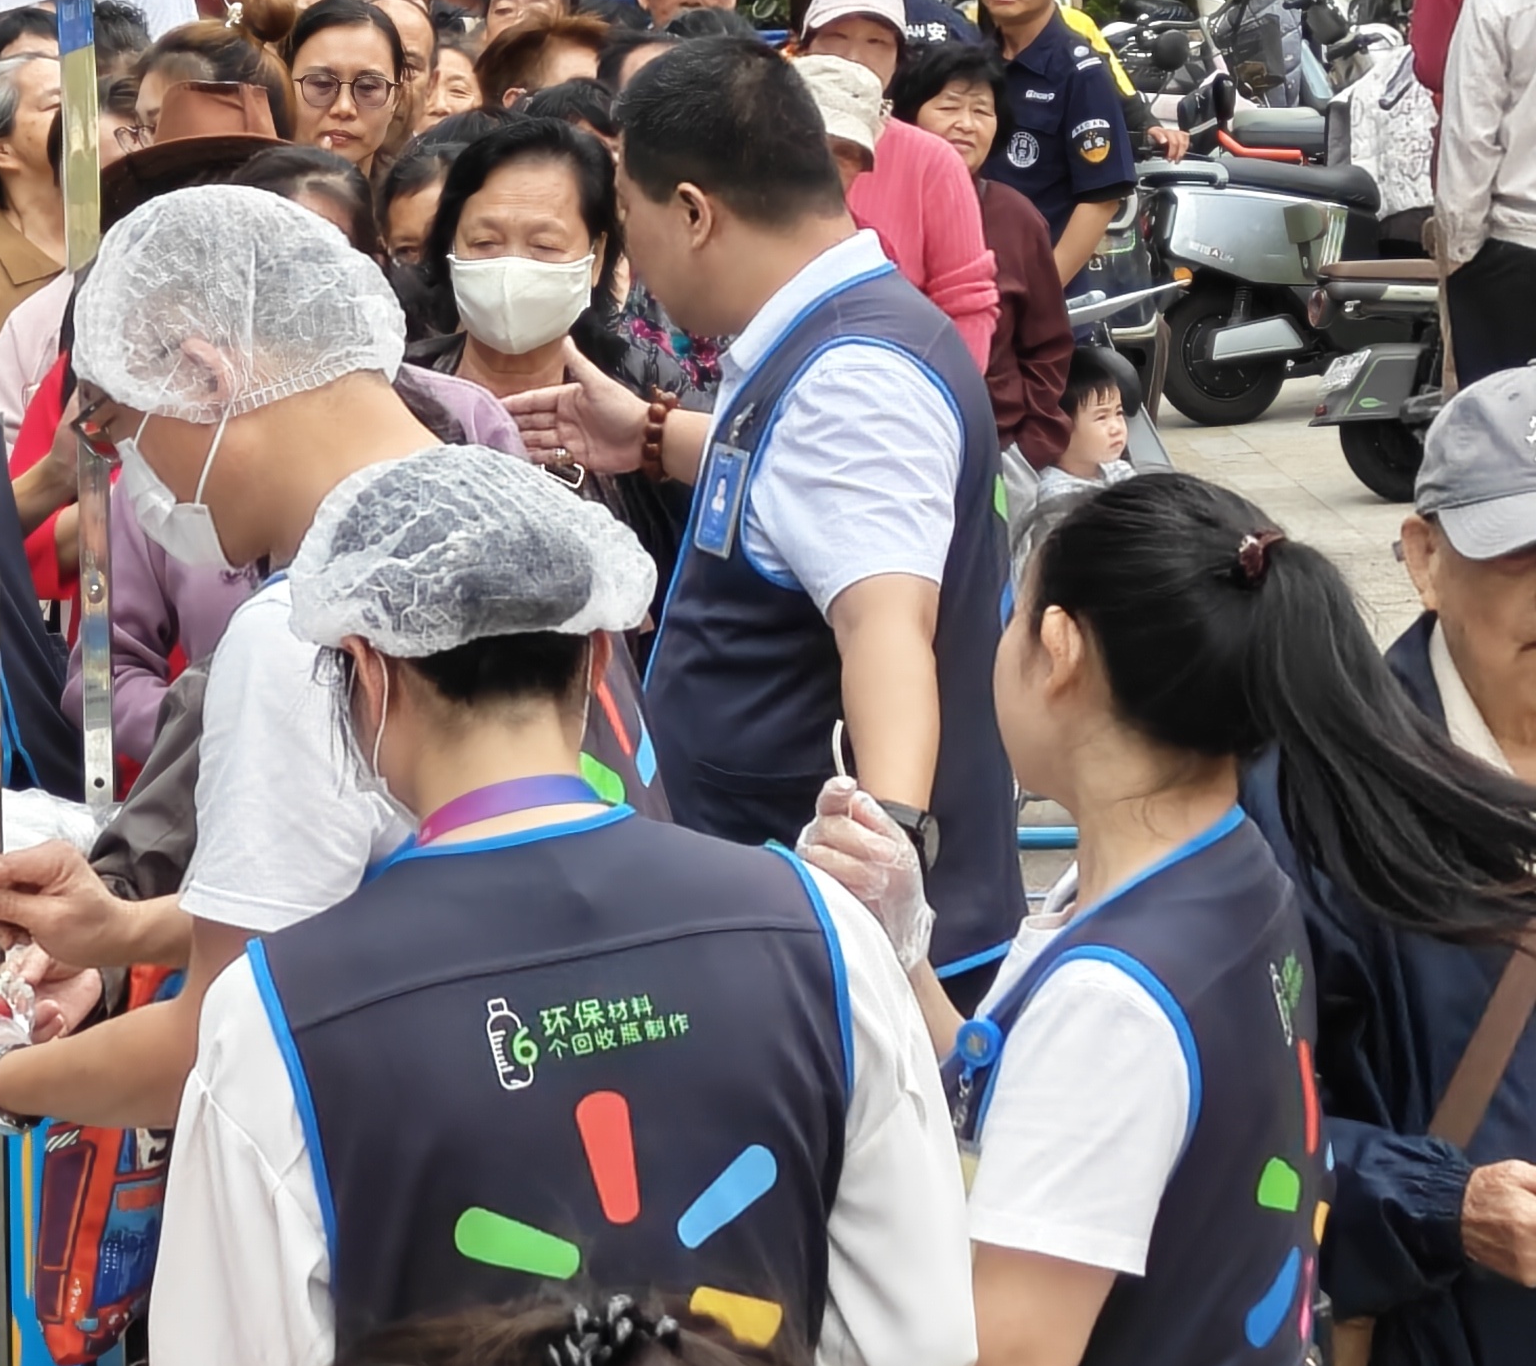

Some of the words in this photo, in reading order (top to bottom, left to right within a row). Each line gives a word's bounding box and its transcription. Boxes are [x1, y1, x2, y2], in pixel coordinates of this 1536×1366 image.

[539, 993, 654, 1037] 环保材料
[548, 1013, 690, 1060] 个回收瓶制作
[514, 1026, 539, 1066] 6
